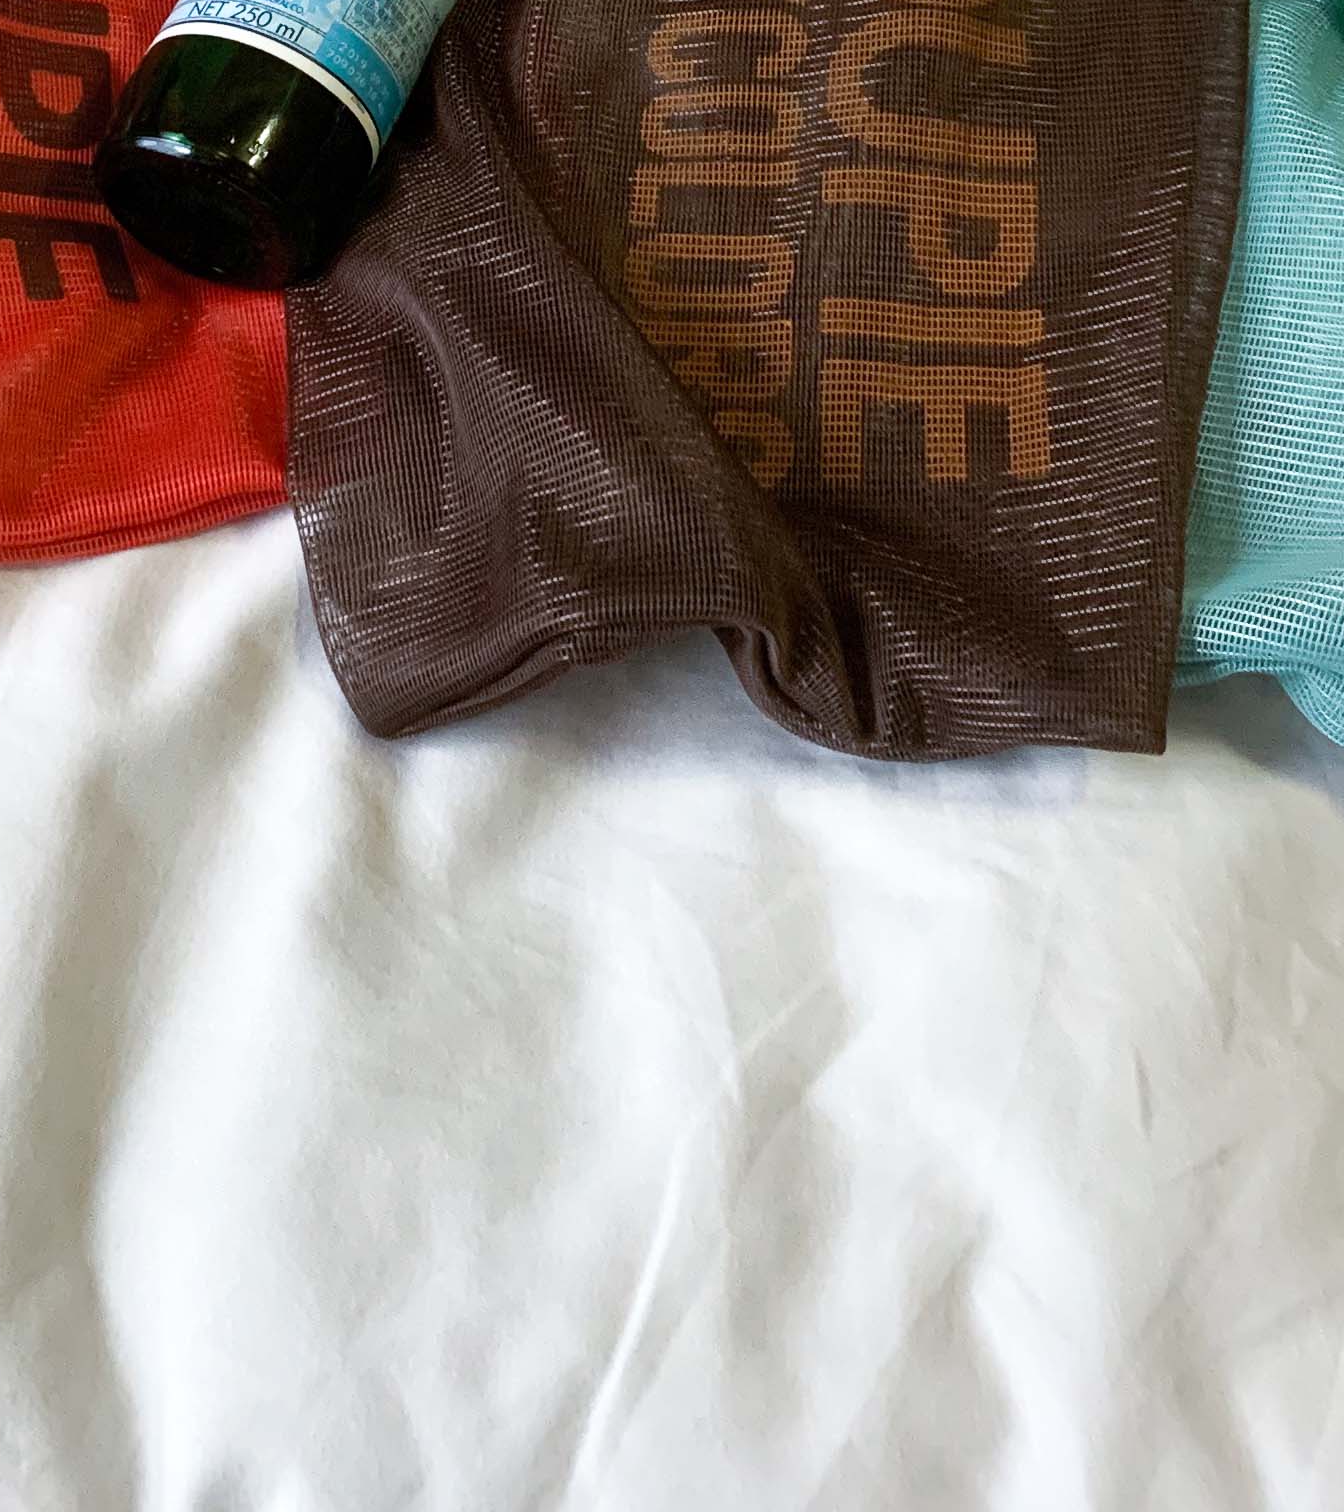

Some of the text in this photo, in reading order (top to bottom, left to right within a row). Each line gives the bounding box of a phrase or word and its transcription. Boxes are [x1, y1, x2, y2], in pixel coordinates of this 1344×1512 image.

[187, 0, 306, 43] NET 250 ml
